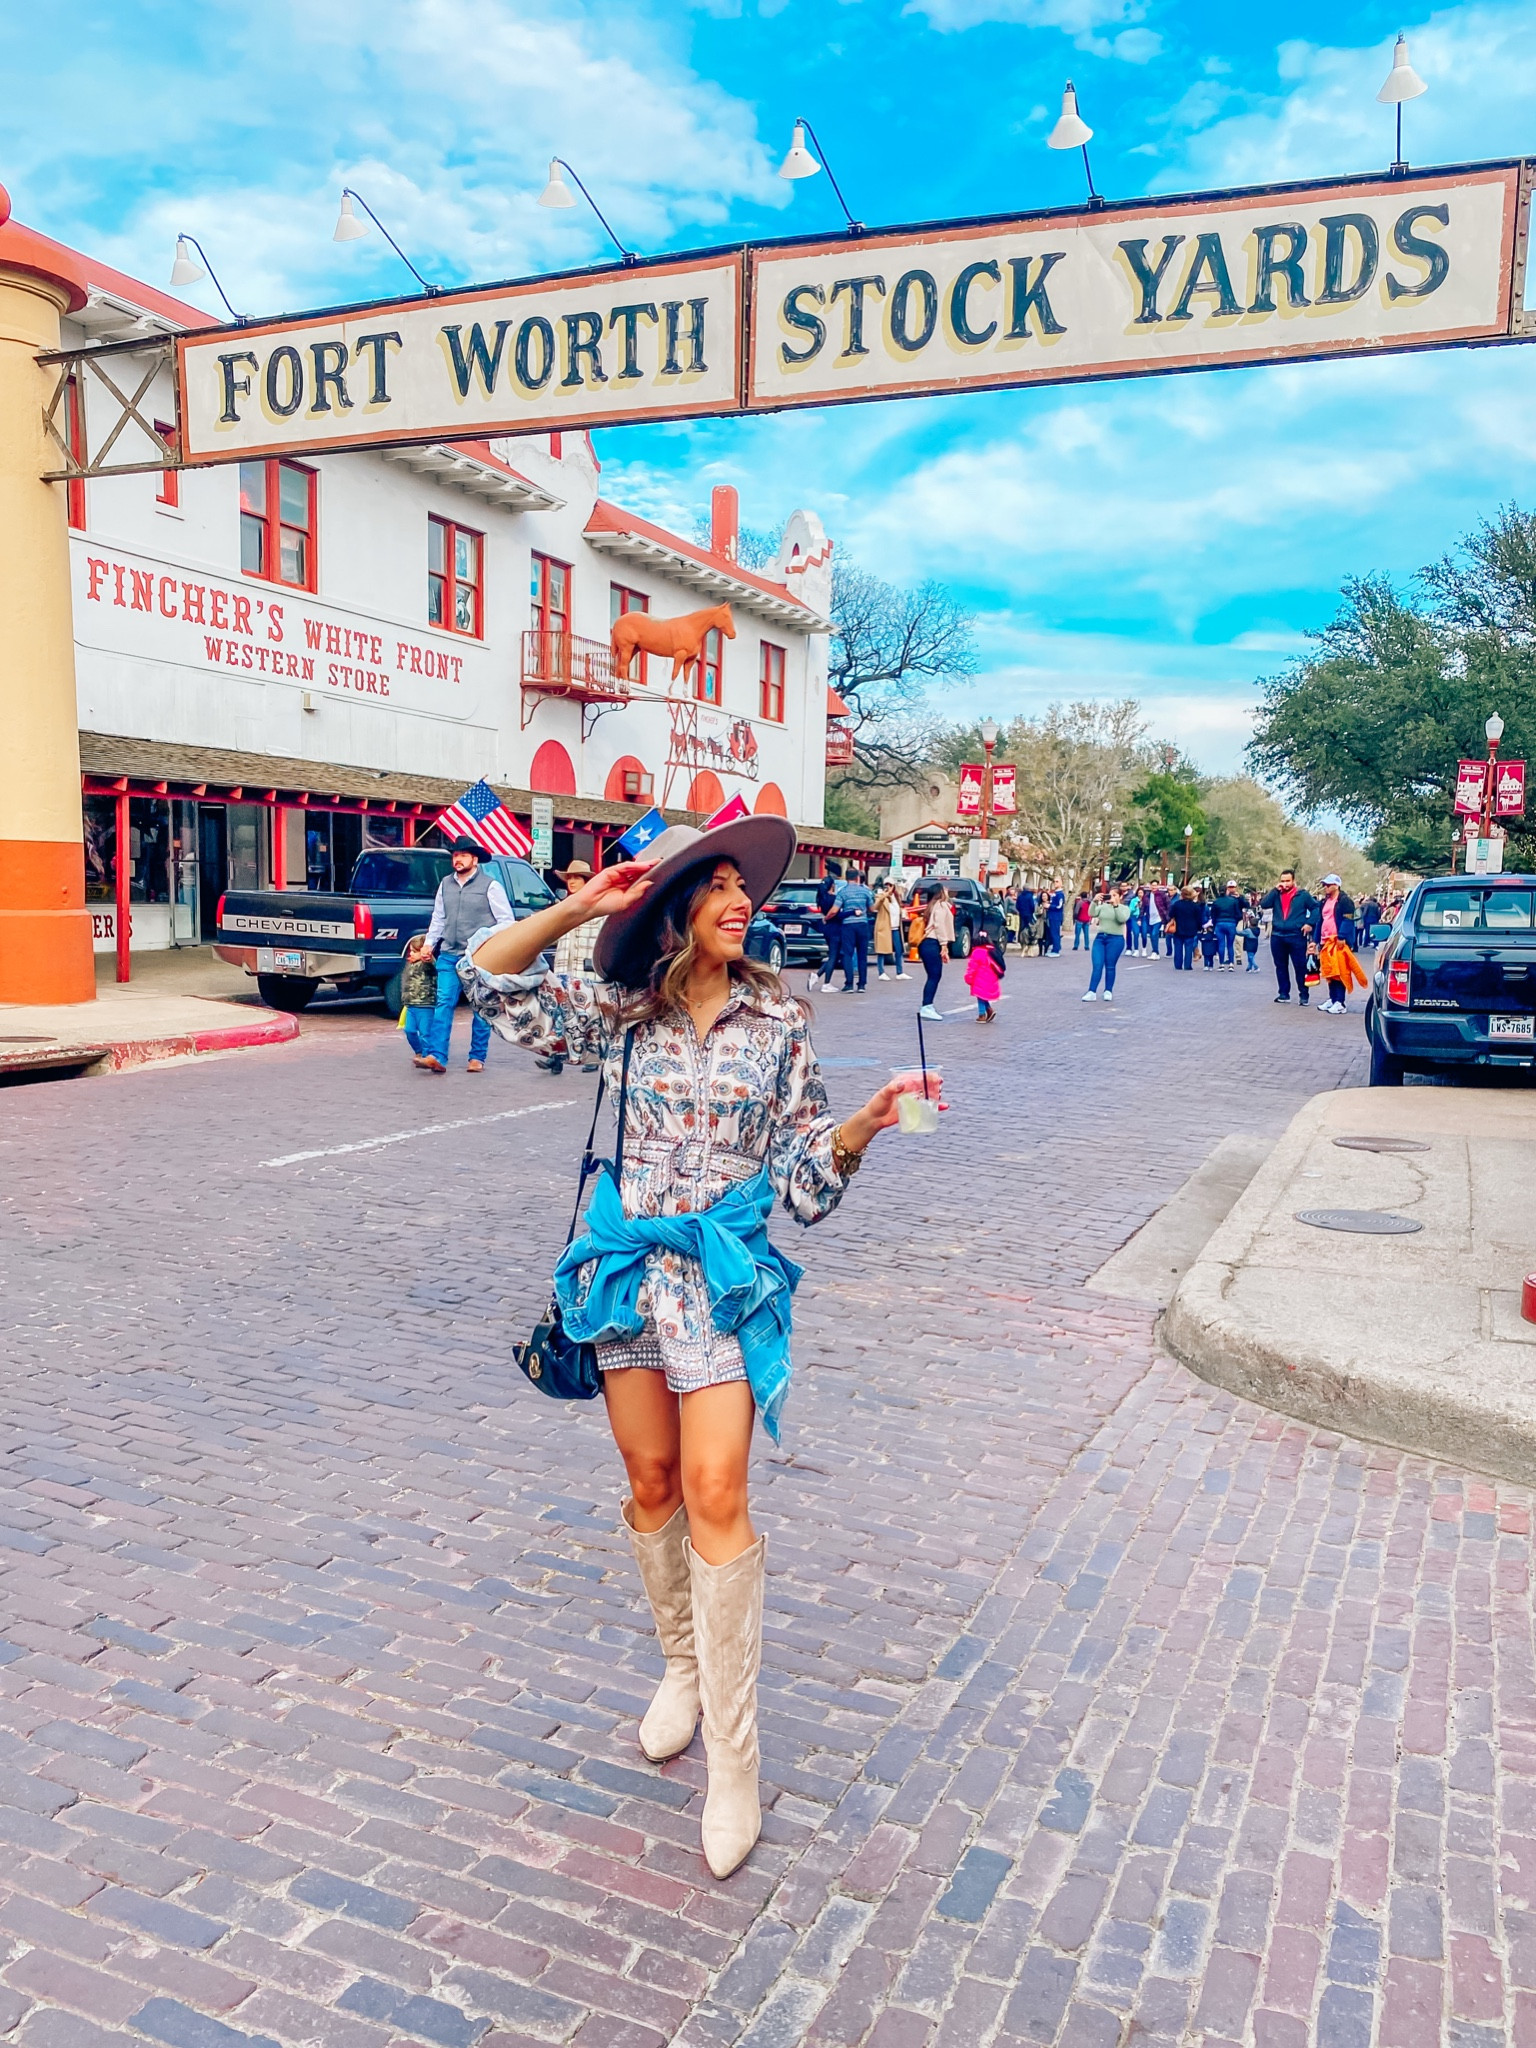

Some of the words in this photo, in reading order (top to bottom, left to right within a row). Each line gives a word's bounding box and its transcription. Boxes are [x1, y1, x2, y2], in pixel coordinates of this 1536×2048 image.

[218, 332, 403, 422] FORT
[441, 298, 709, 398] WORTH
[780, 251, 1067, 365] STOCK
[1118, 203, 1449, 324] YARDS
[87, 557, 284, 642] FINCHER'S
[303, 618, 383, 665] WHITE
[397, 642, 463, 683] FRONT
[204, 635, 314, 681] WESTERN
[328, 663, 390, 696] STORE
[236, 918, 341, 935] CHEVROLET
[375, 928, 399, 940] Z71
[1413, 999, 1460, 1007] HONDA
